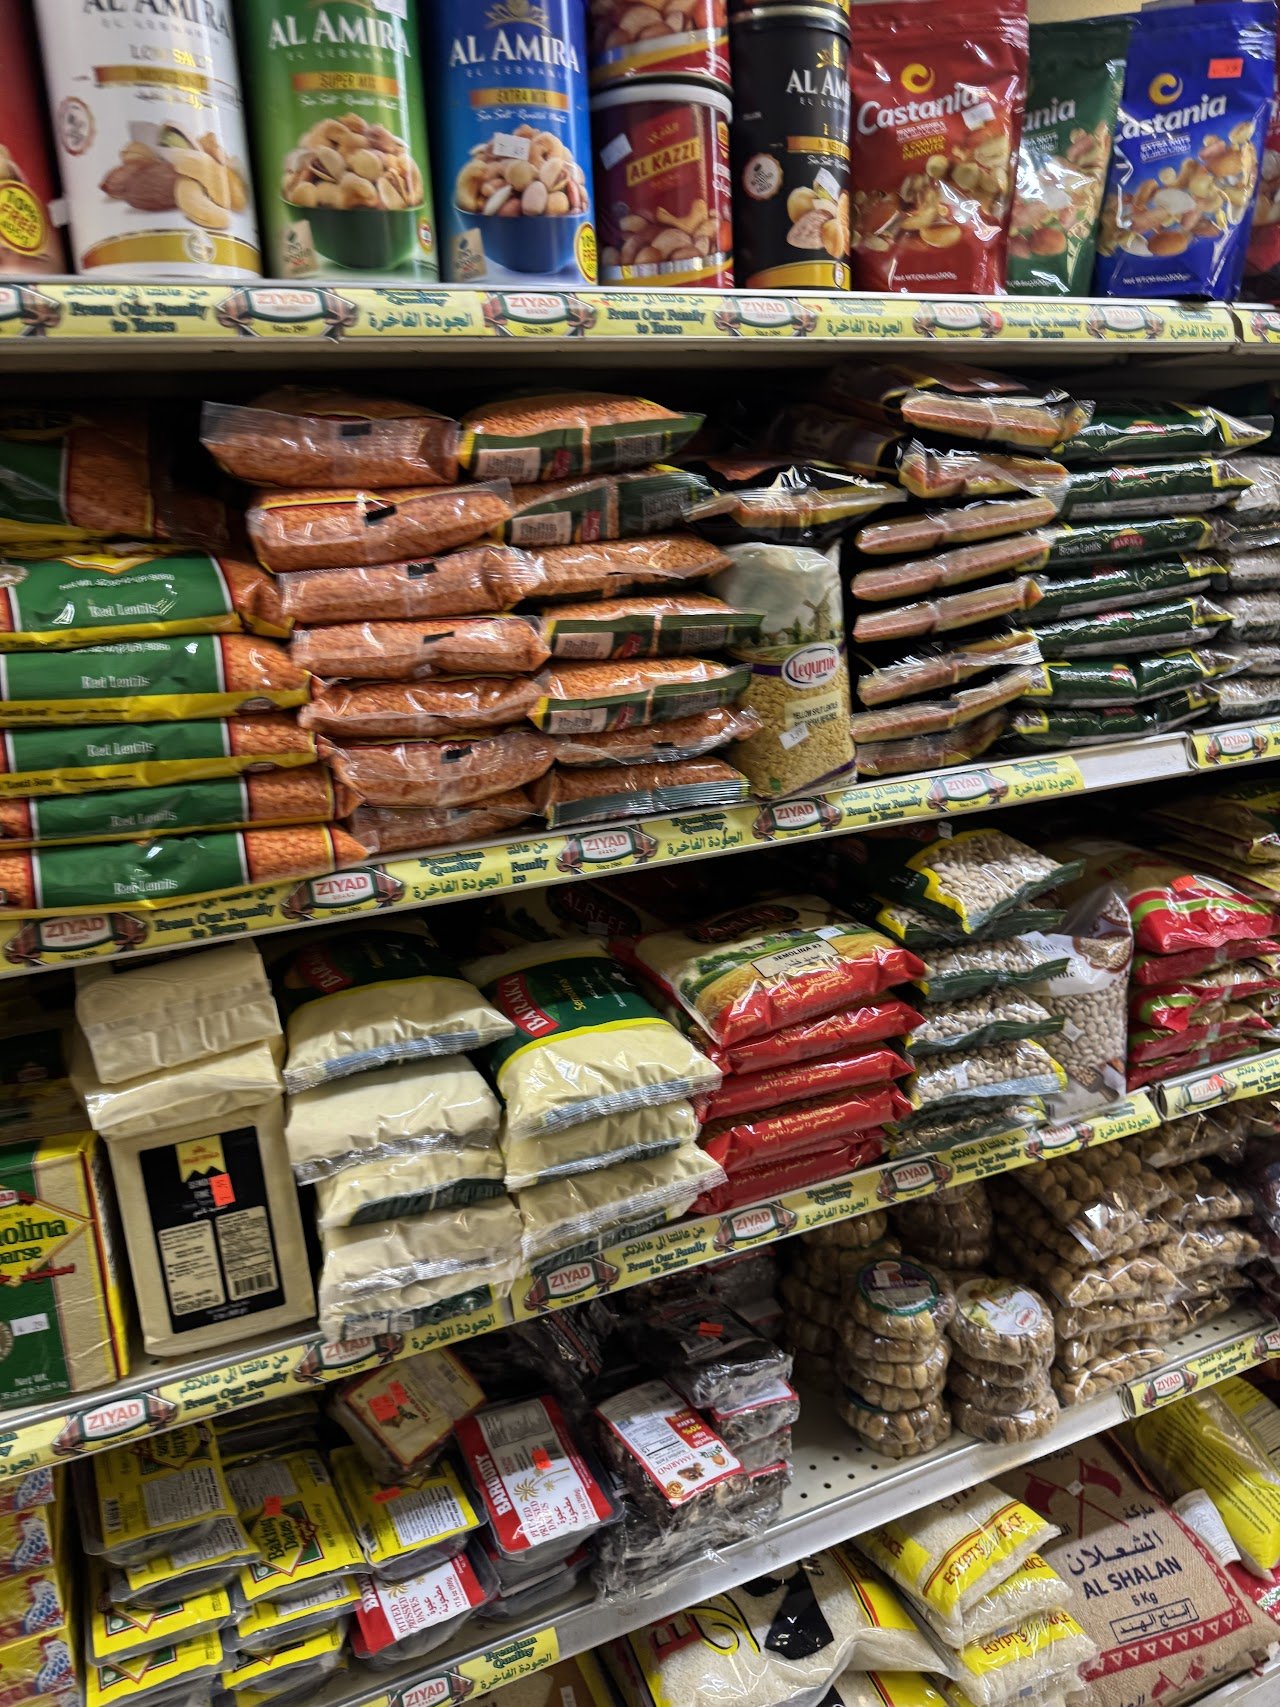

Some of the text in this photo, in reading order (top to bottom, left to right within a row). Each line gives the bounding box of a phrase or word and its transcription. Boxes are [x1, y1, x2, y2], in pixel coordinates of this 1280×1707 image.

[268, 15, 306, 50] AL
[312, 9, 411, 58] AMIRA
[449, 29, 580, 73] AL AMIRA
[786, 69, 817, 94] AL
[857, 82, 980, 136] Castania
[1114, 94, 1226, 142] astania
[629, 143, 697, 182] AL KAZZI
[257, 293, 315, 306] ZIYAD
[510, 296, 561, 309] ZIYAD
[742, 300, 786, 312] ZIYAD
[70, 302, 209, 321] From Our Family
[607, 307, 706, 324] From Our Family
[938, 305, 974, 317] ZIYAD
[1107, 310, 1139, 321] ZIYAD
[111, 320, 130, 334] to
[636, 322, 649, 334] to
[89, 602, 159, 618] Red Lentils
[81, 675, 151, 689] Red Lentils
[86, 741, 155, 758] Red Lentils
[1222, 734, 1249, 747] ZIYAD
[946, 776, 981, 791] ZIYAD
[775, 803, 815, 820] ZIYAD
[873, 801, 892, 813] Our
[681, 821, 724, 837] Quality
[584, 833, 627, 852] ZIYAD
[667, 837, 705, 859] الفاخرة
[419, 850, 486, 868] Premium
[429, 859, 482, 877] Quality
[315, 876, 369, 897] ZIYAD
[412, 872, 504, 901] الجودة الفاخرة
[45, 917, 106, 939] ZIYAD
[197, 911, 226, 926] Our
[772, 946, 812, 962] SEMOLINA
[504, 977, 549, 1033] BARAKA
[894, 1166, 930, 1184] ZIYAD
[736, 1212, 771, 1231] ZIYAD
[804, 1206, 838, 1226] الفاخرة
[626, 1240, 708, 1273] From Our Family
[549, 1265, 592, 1289] ZIYAD
[650, 1266, 662, 1276] to
[411, 1313, 496, 1352] الجودة الفاخرة
[184, 1371, 289, 1411] From Our Family
[1155, 1373, 1181, 1392] ZIYAD
[87, 1403, 140, 1431] ZIYAD
[657, 1452, 697, 1476] TAMARIND
[475, 1454, 513, 1517] BAROODY
[1066, 1528, 1165, 1577] الشعلان
[1022, 1556, 1048, 1573] RICE
[1082, 1556, 1183, 1603] AL SHALAN
[408, 1595, 426, 1624] DATES
[423, 1596, 438, 1617] عجوة
[1140, 1591, 1159, 1608] Kg
[390, 1603, 409, 1633] PITTED
[398, 1595, 419, 1631] PRESSED
[1119, 1617, 1157, 1640] الهند
[485, 1636, 538, 1664] Premium
[492, 1646, 536, 1670] Quality
[480, 1652, 553, 1691] الجودة الفاخرة
[405, 1680, 447, 1707] ZIYAD
